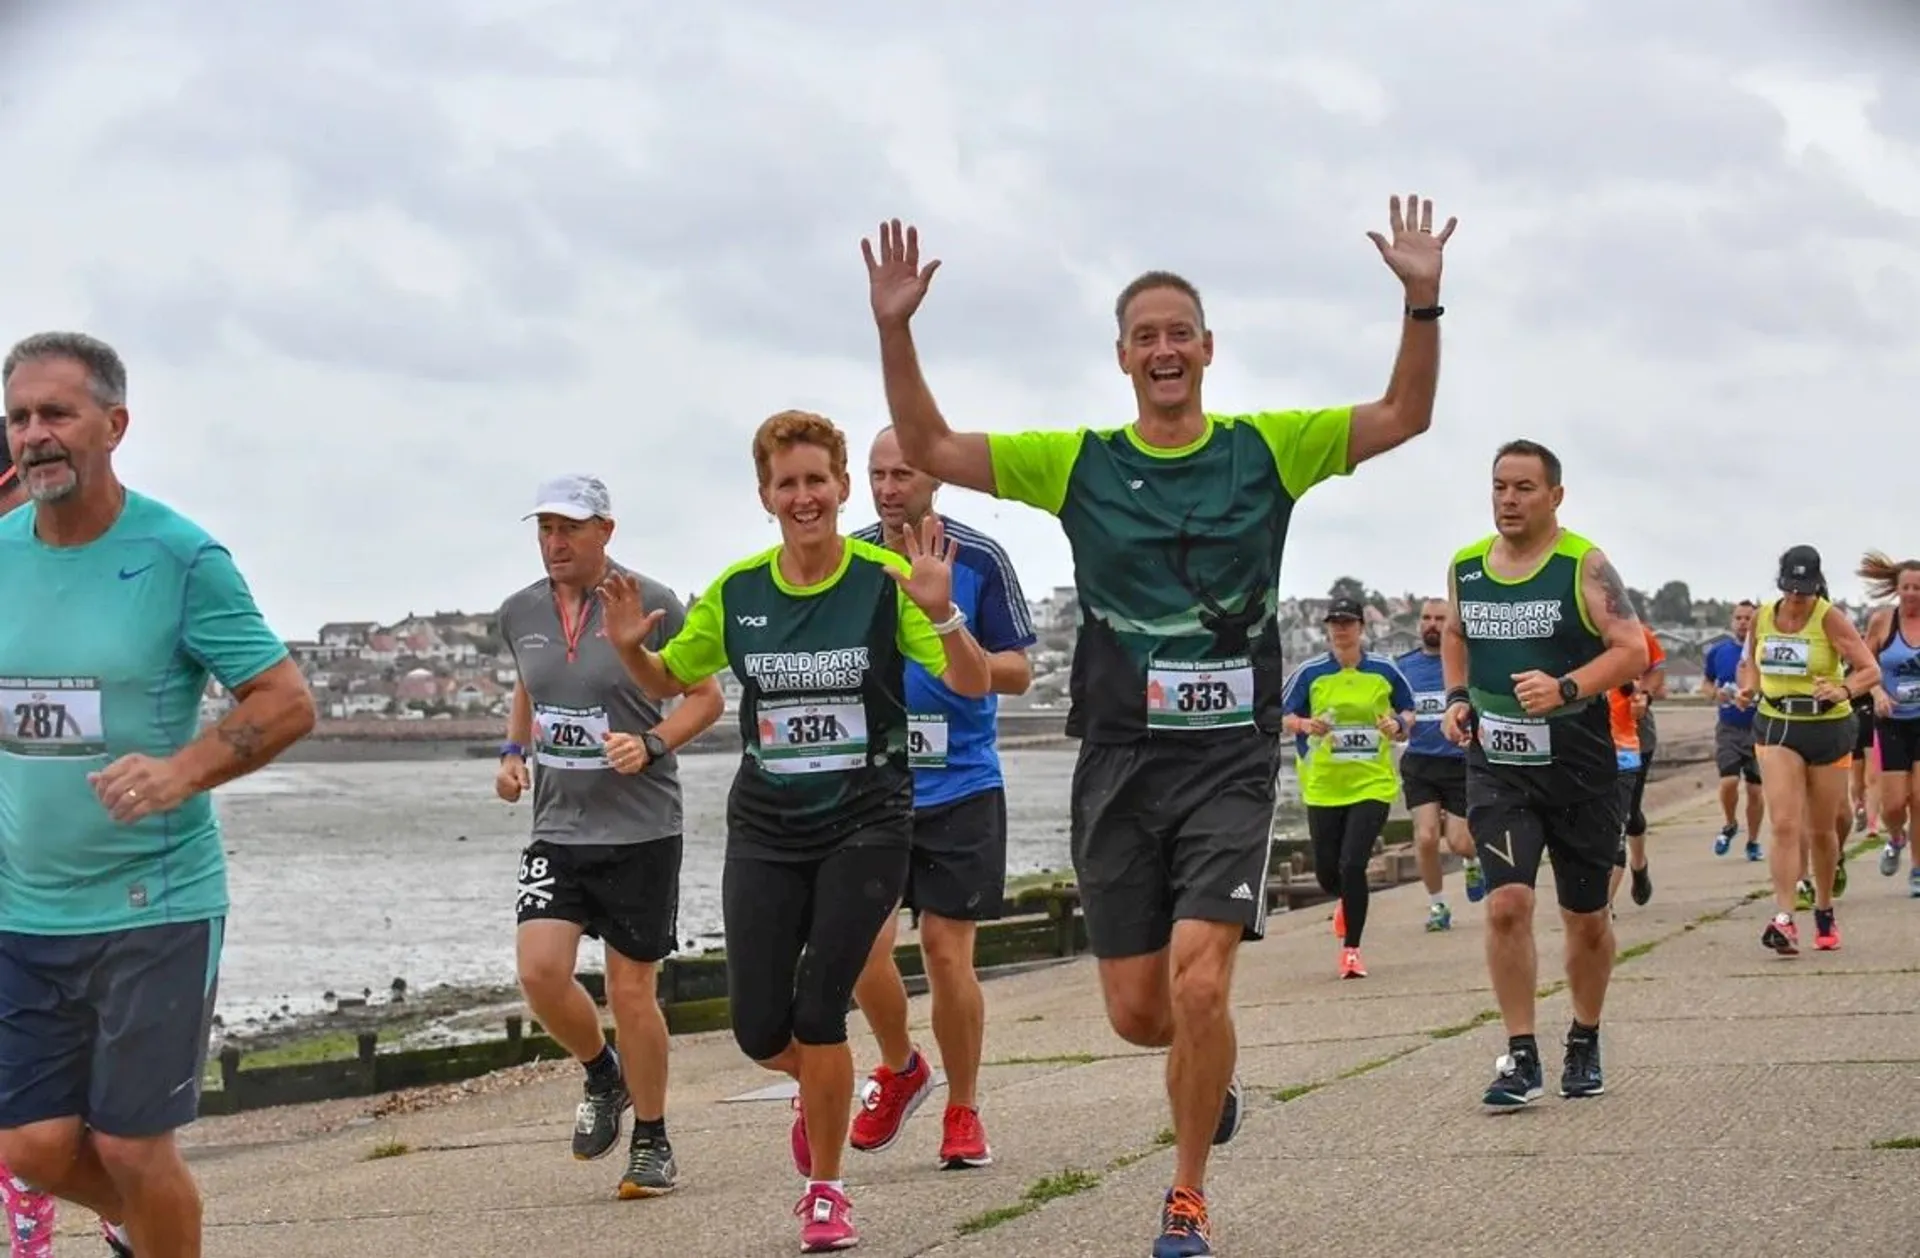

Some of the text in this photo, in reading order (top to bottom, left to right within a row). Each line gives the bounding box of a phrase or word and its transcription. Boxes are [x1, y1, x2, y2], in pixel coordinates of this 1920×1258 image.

[1514, 601, 1561, 620] PARK
[1467, 619, 1554, 638] WARRIORS
[746, 648, 868, 674] WEALD PARK
[757, 668, 862, 691] WARRIORS
[1177, 681, 1228, 711] 333
[15, 703, 66, 738] 287
[787, 714, 839, 744] 334
[551, 722, 588, 746] 242
[1492, 729, 1528, 752] 335
